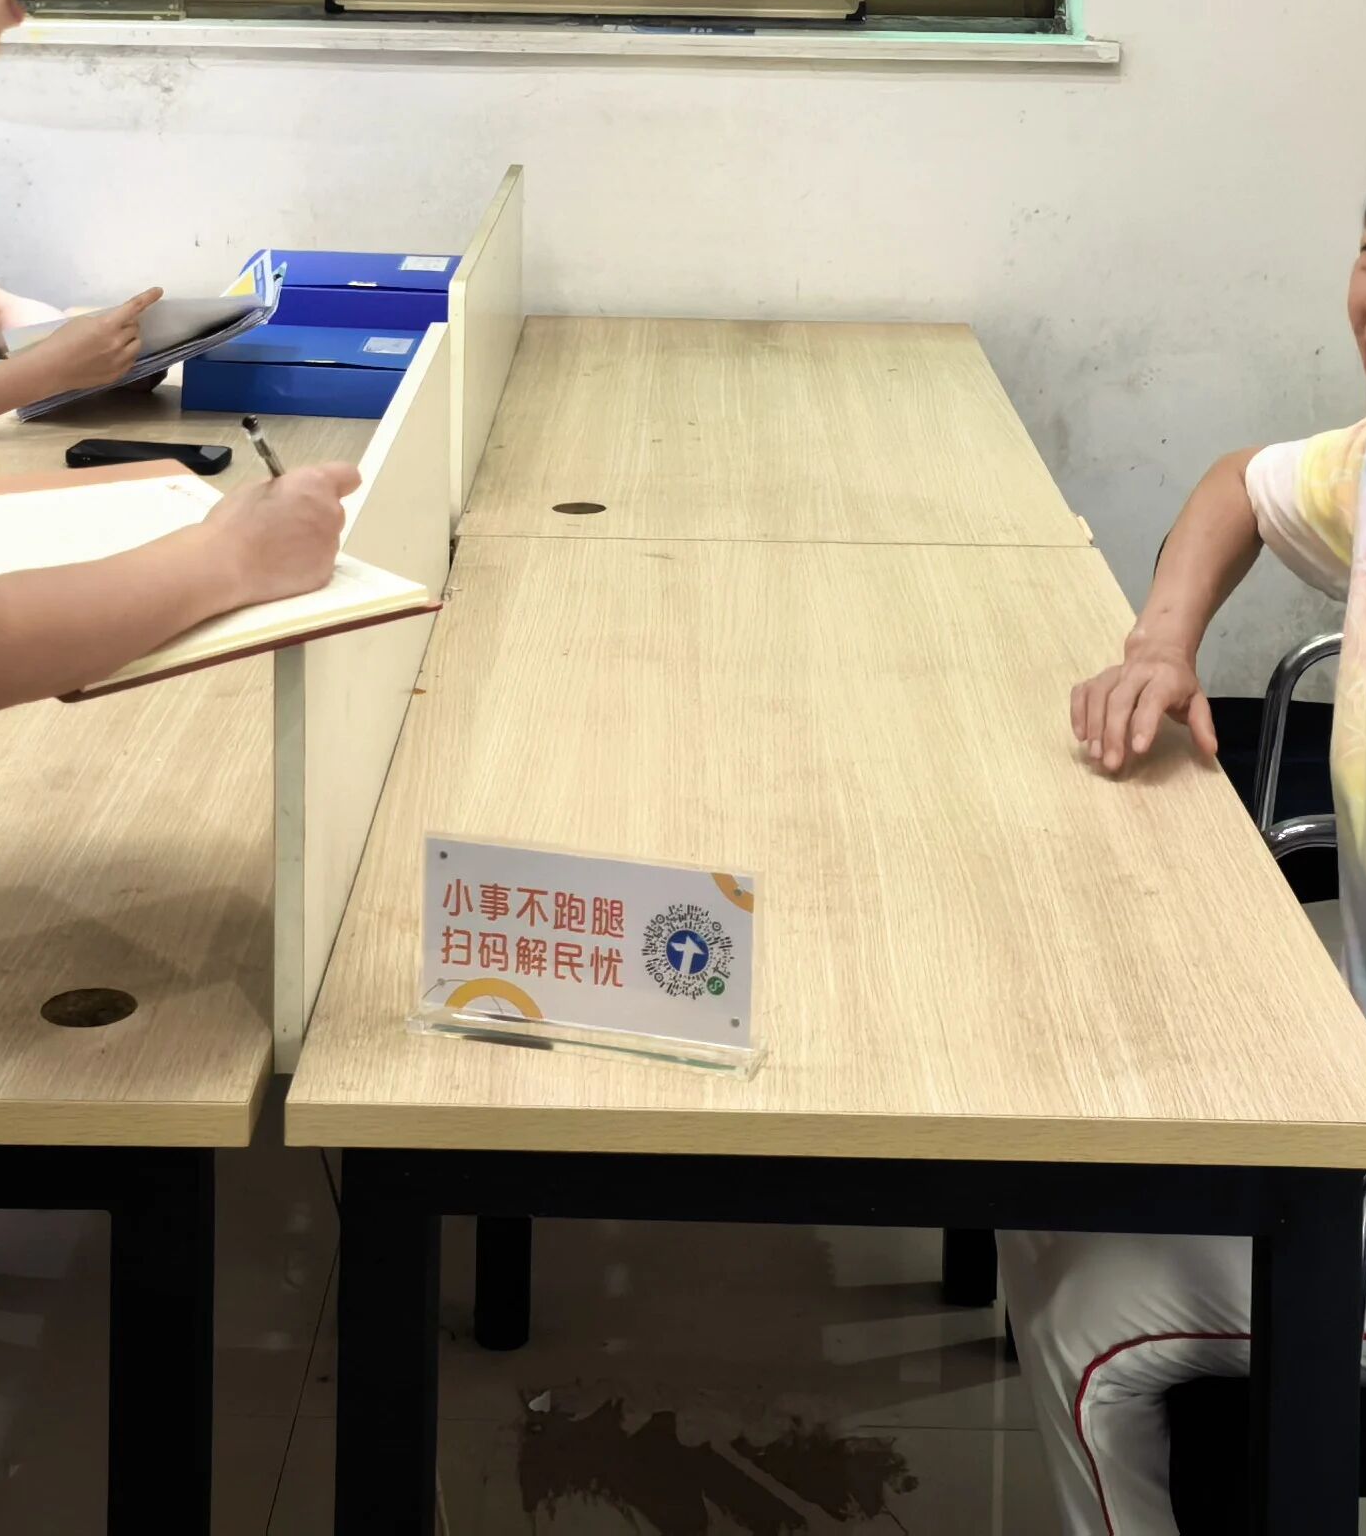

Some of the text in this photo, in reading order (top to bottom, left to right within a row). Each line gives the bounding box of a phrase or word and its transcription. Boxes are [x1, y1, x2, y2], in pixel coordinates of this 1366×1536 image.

[442, 878, 625, 939] 小事不跑腿
[440, 925, 625, 988] 扫码解民忧
